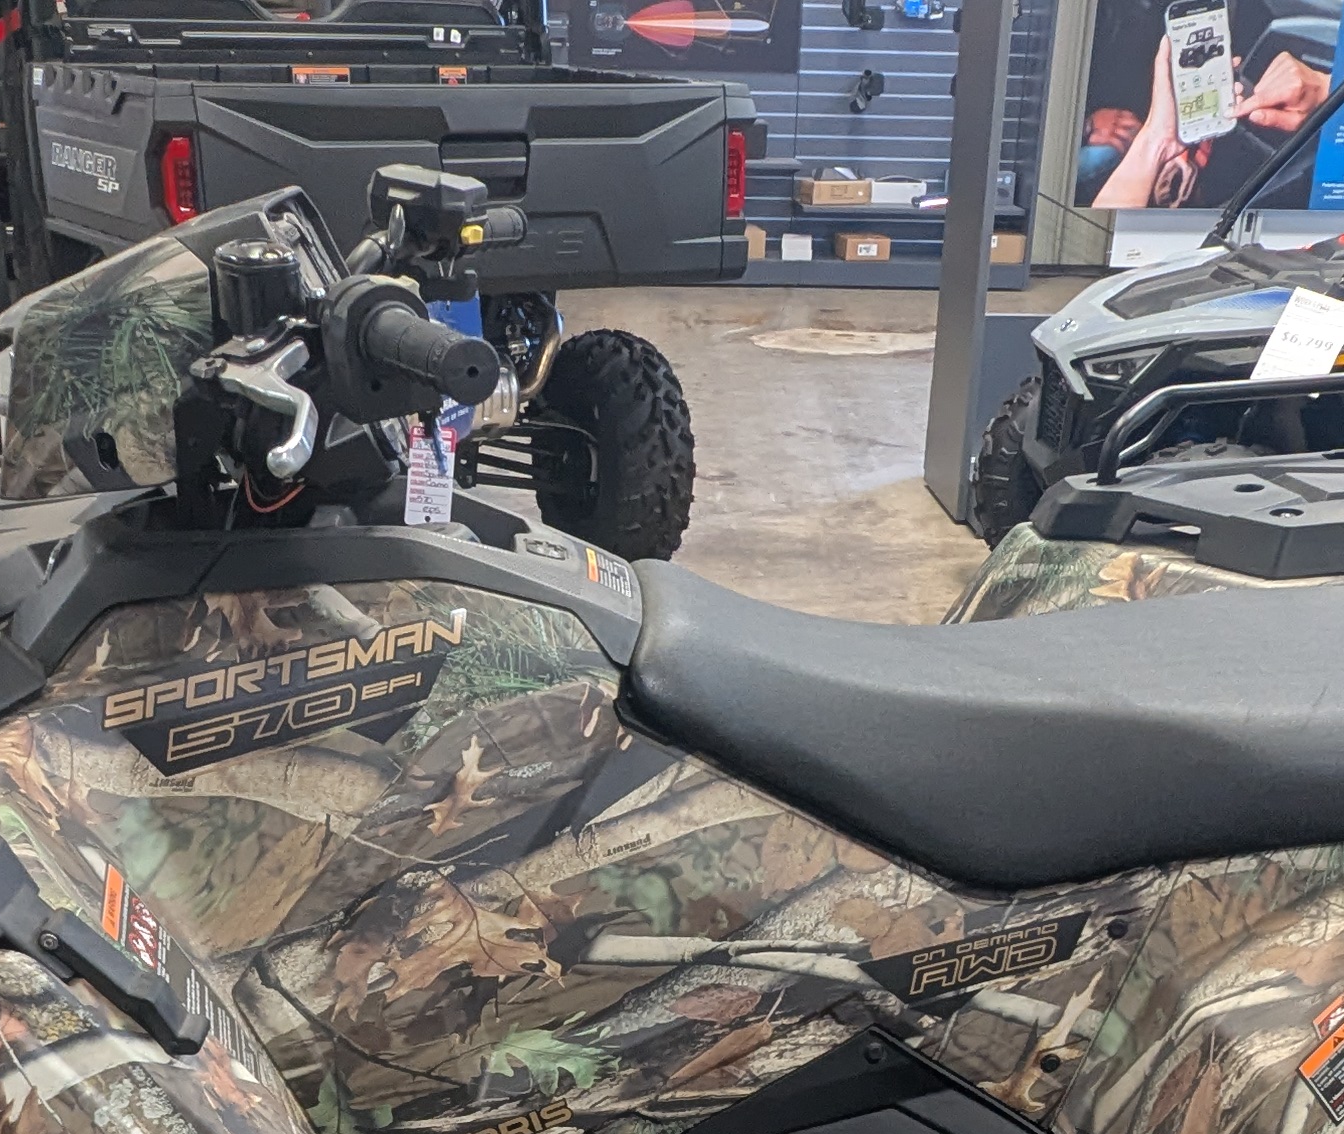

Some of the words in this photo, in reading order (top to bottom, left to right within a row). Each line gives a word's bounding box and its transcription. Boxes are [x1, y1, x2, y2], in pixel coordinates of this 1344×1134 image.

[52, 142, 116, 180] RANGER
[97, 179, 119, 193] SP
[103, 607, 468, 729] SPORTSMAN
[166, 684, 356, 762] 570
[361, 671, 422, 700] EFI
[909, 936, 1058, 995] AWD
[912, 949, 945, 965] ON
[956, 922, 1058, 953] DEMAND
